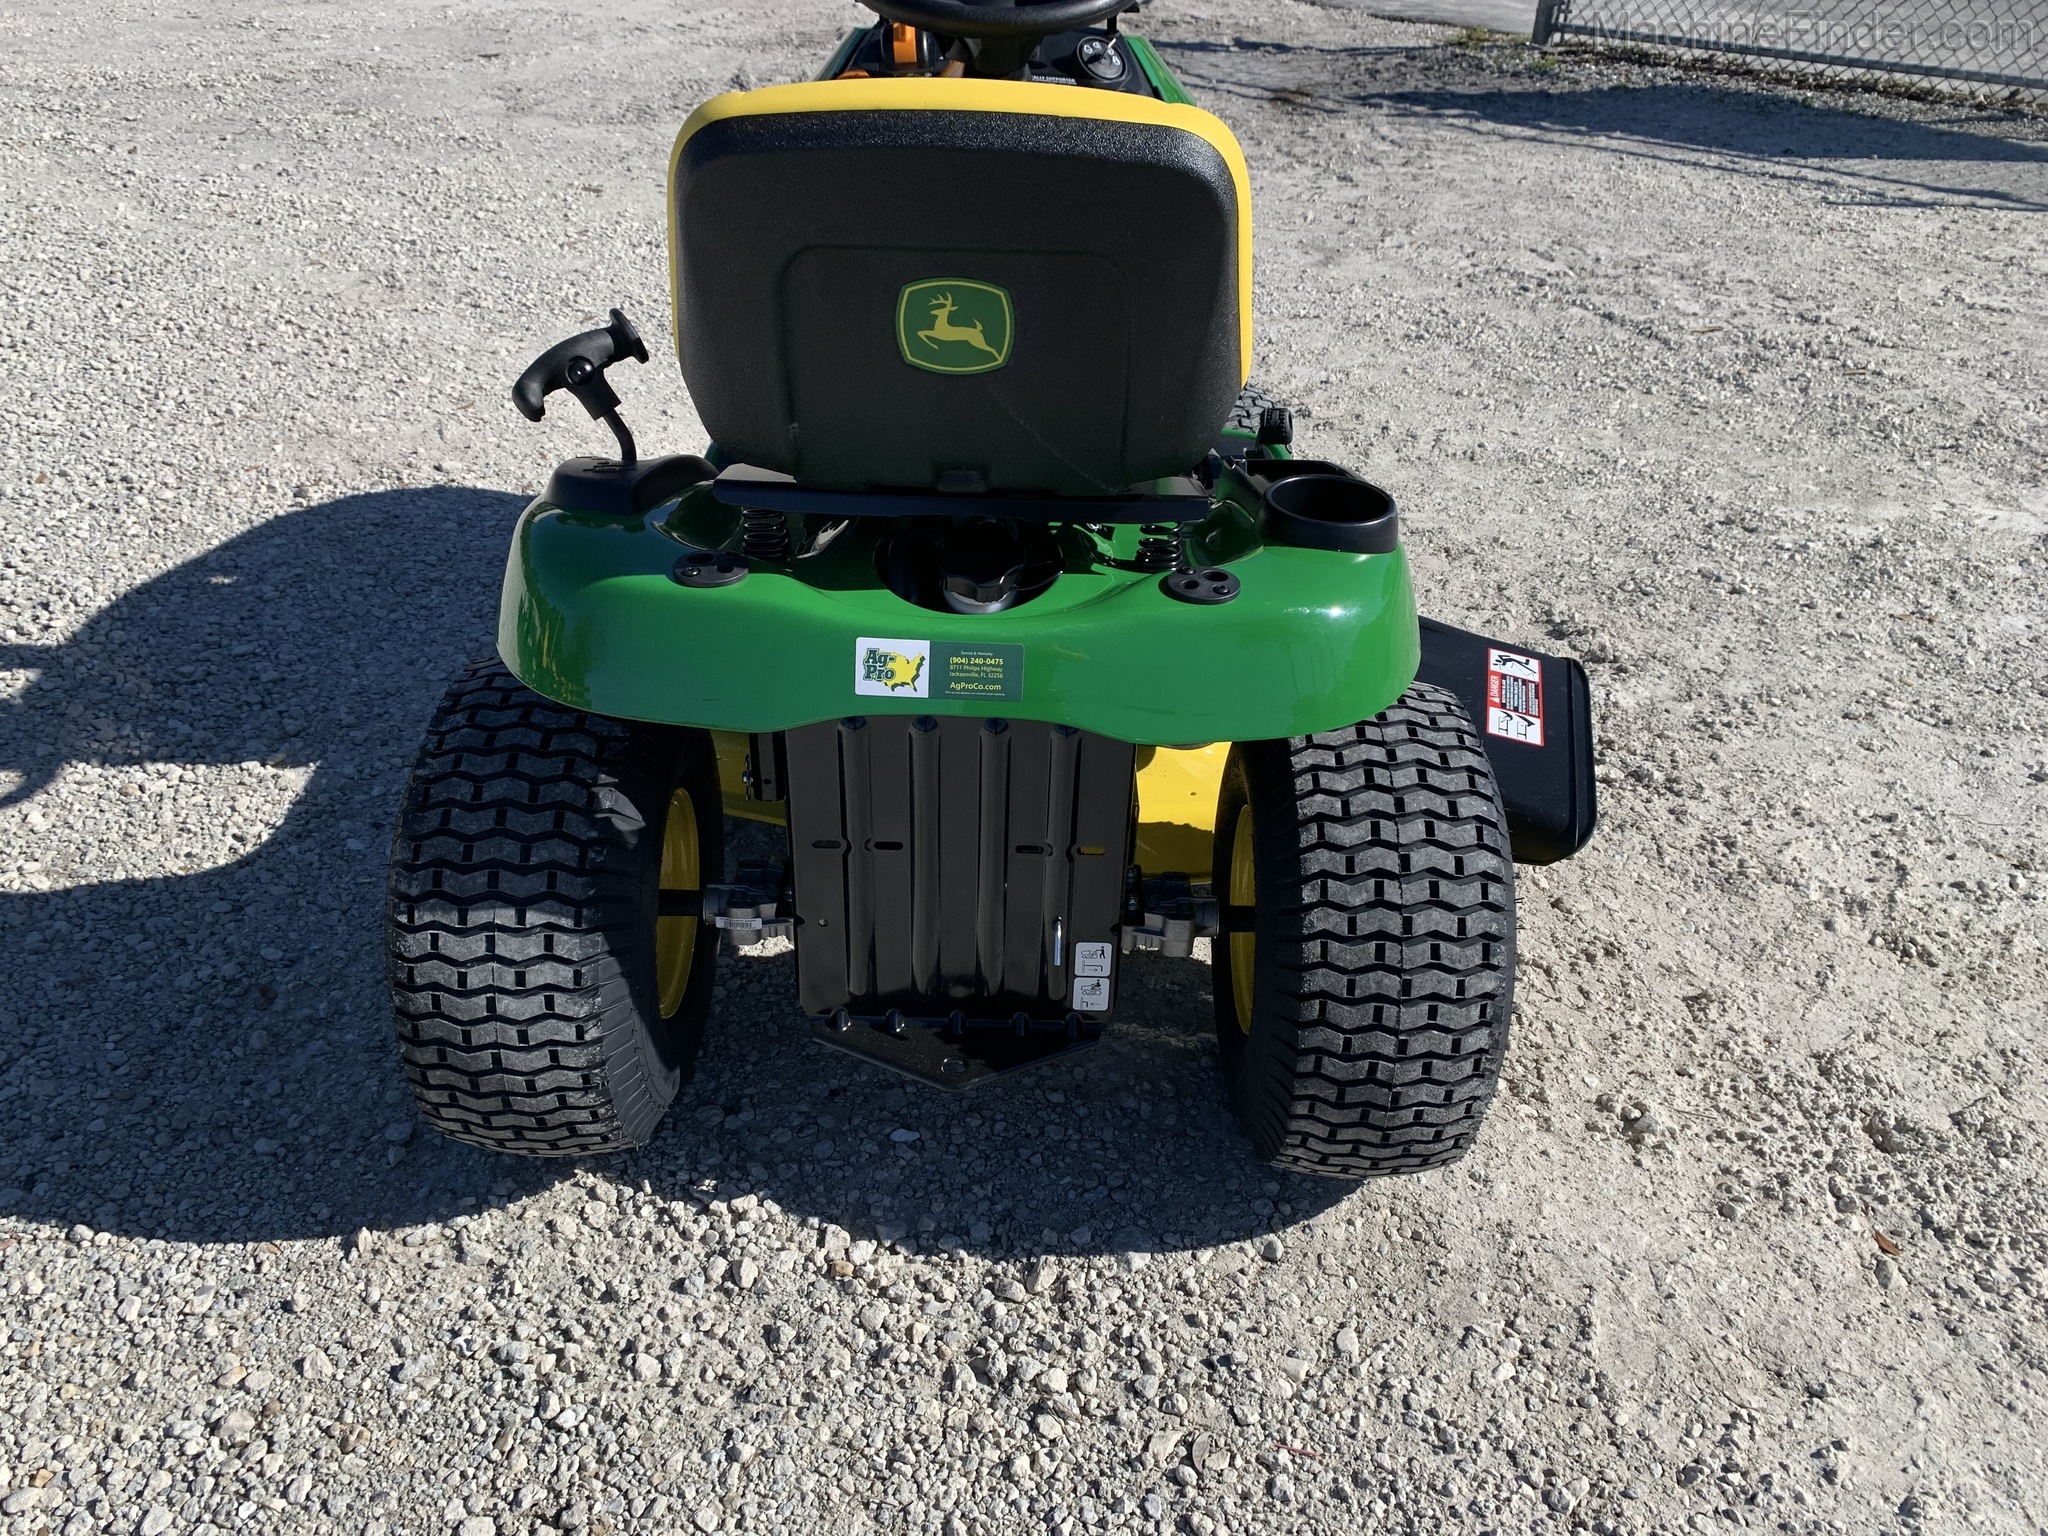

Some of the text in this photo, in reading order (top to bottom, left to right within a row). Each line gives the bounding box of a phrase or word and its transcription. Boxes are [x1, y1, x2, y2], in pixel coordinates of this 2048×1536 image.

[864, 649, 896, 668] Ag-
[970, 657, 1004, 665] 240-0475
[864, 665, 896, 680] Pro
[950, 681, 1002, 690] AgProCo.com
[1490, 675, 1500, 697] DANGER
